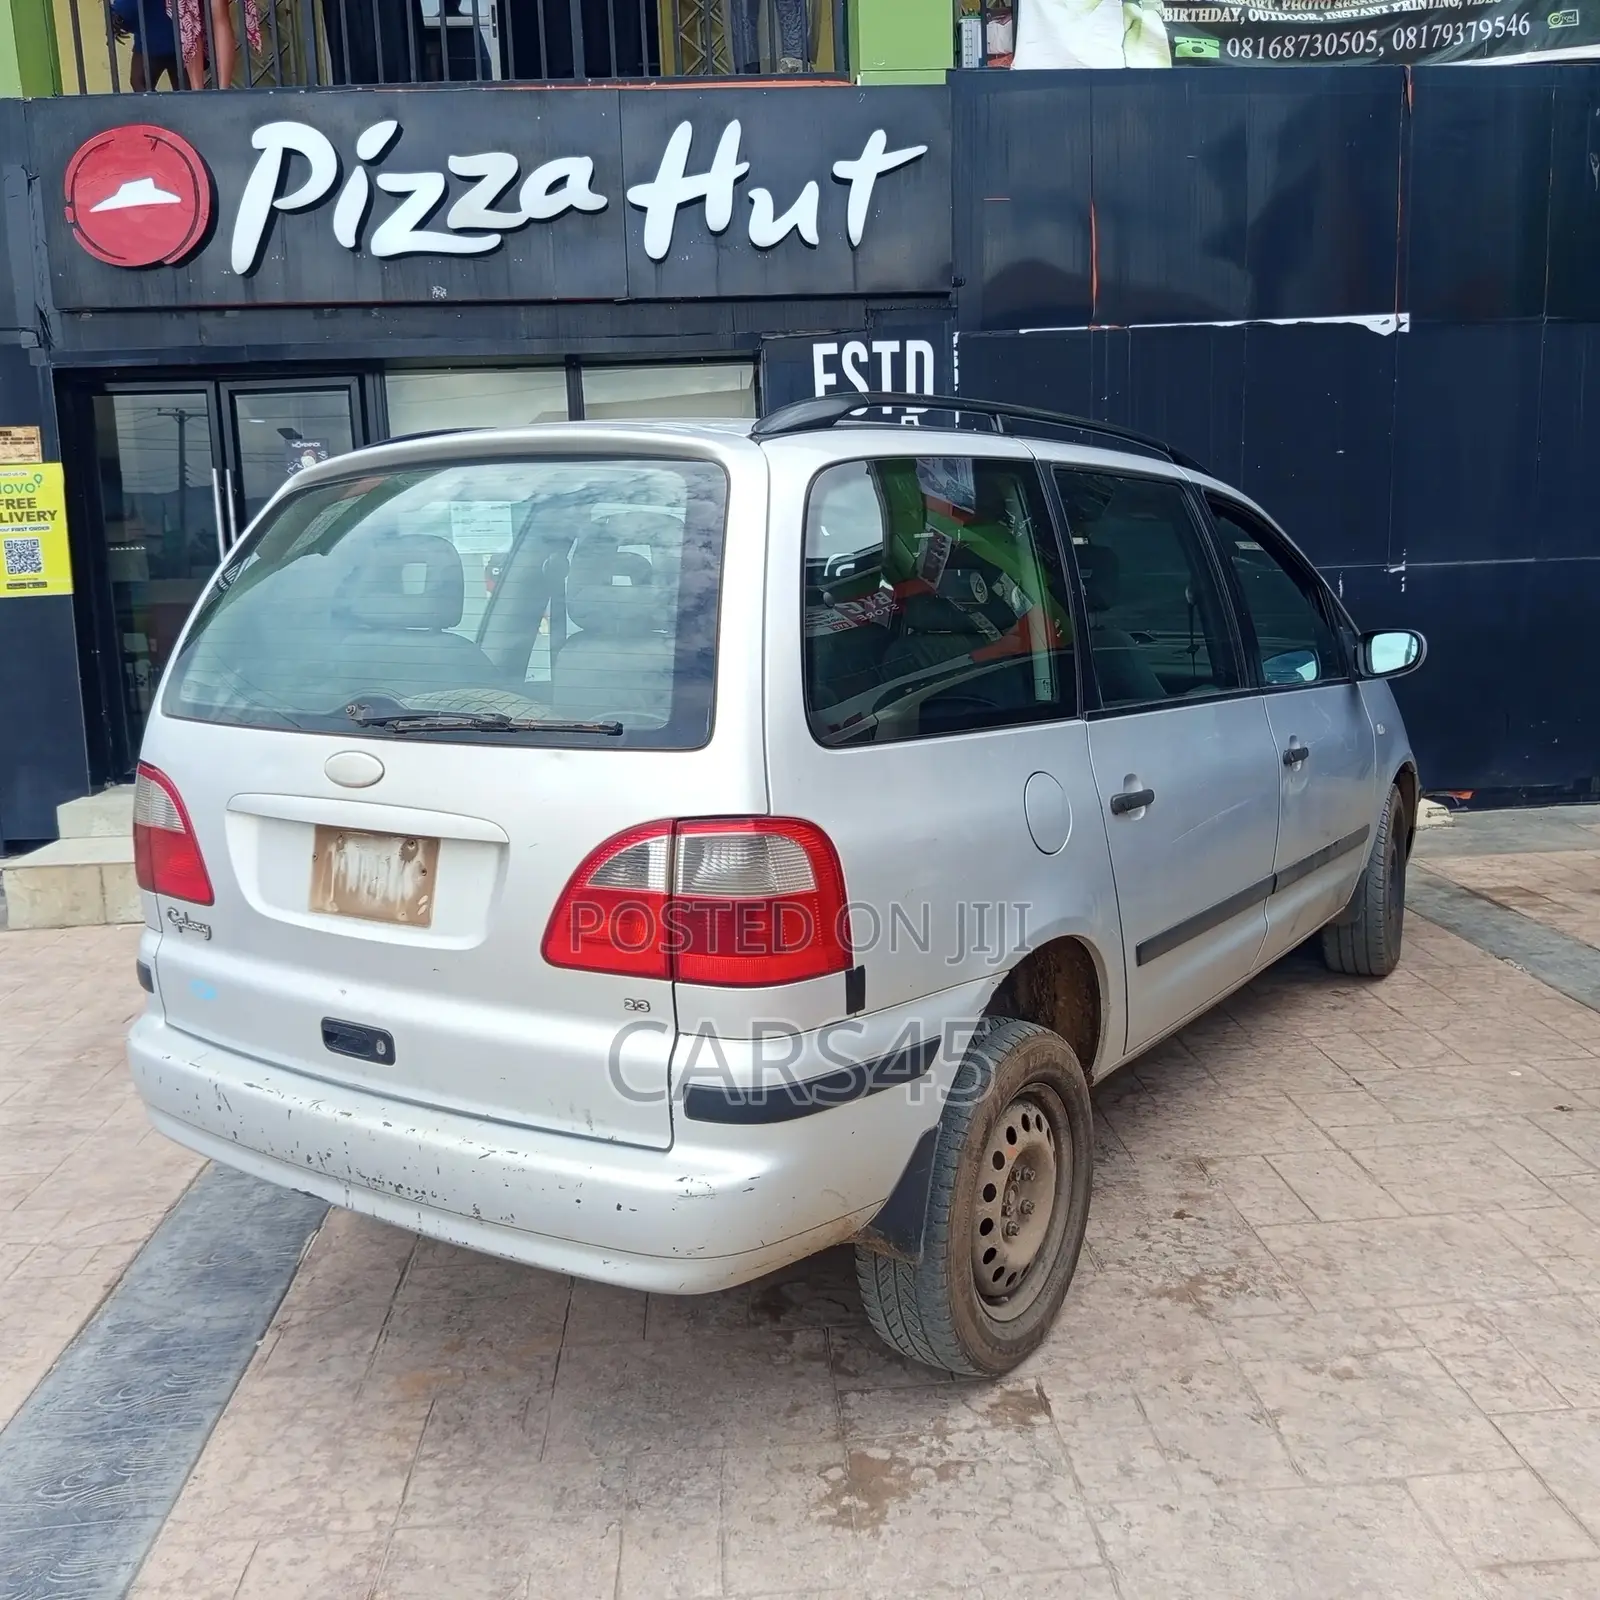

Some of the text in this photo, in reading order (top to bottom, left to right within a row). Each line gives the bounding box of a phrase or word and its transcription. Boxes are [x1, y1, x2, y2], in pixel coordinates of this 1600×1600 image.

[1163, 7, 1246, 25] BIRTHDAY,
[1248, 8, 1324, 22] OUTDOOR,
[1324, 5, 1389, 20] INSTANT
[1226, 12, 1531, 60] 08168730505, 08179379546
[231, 118, 929, 276] Pizza Hut
